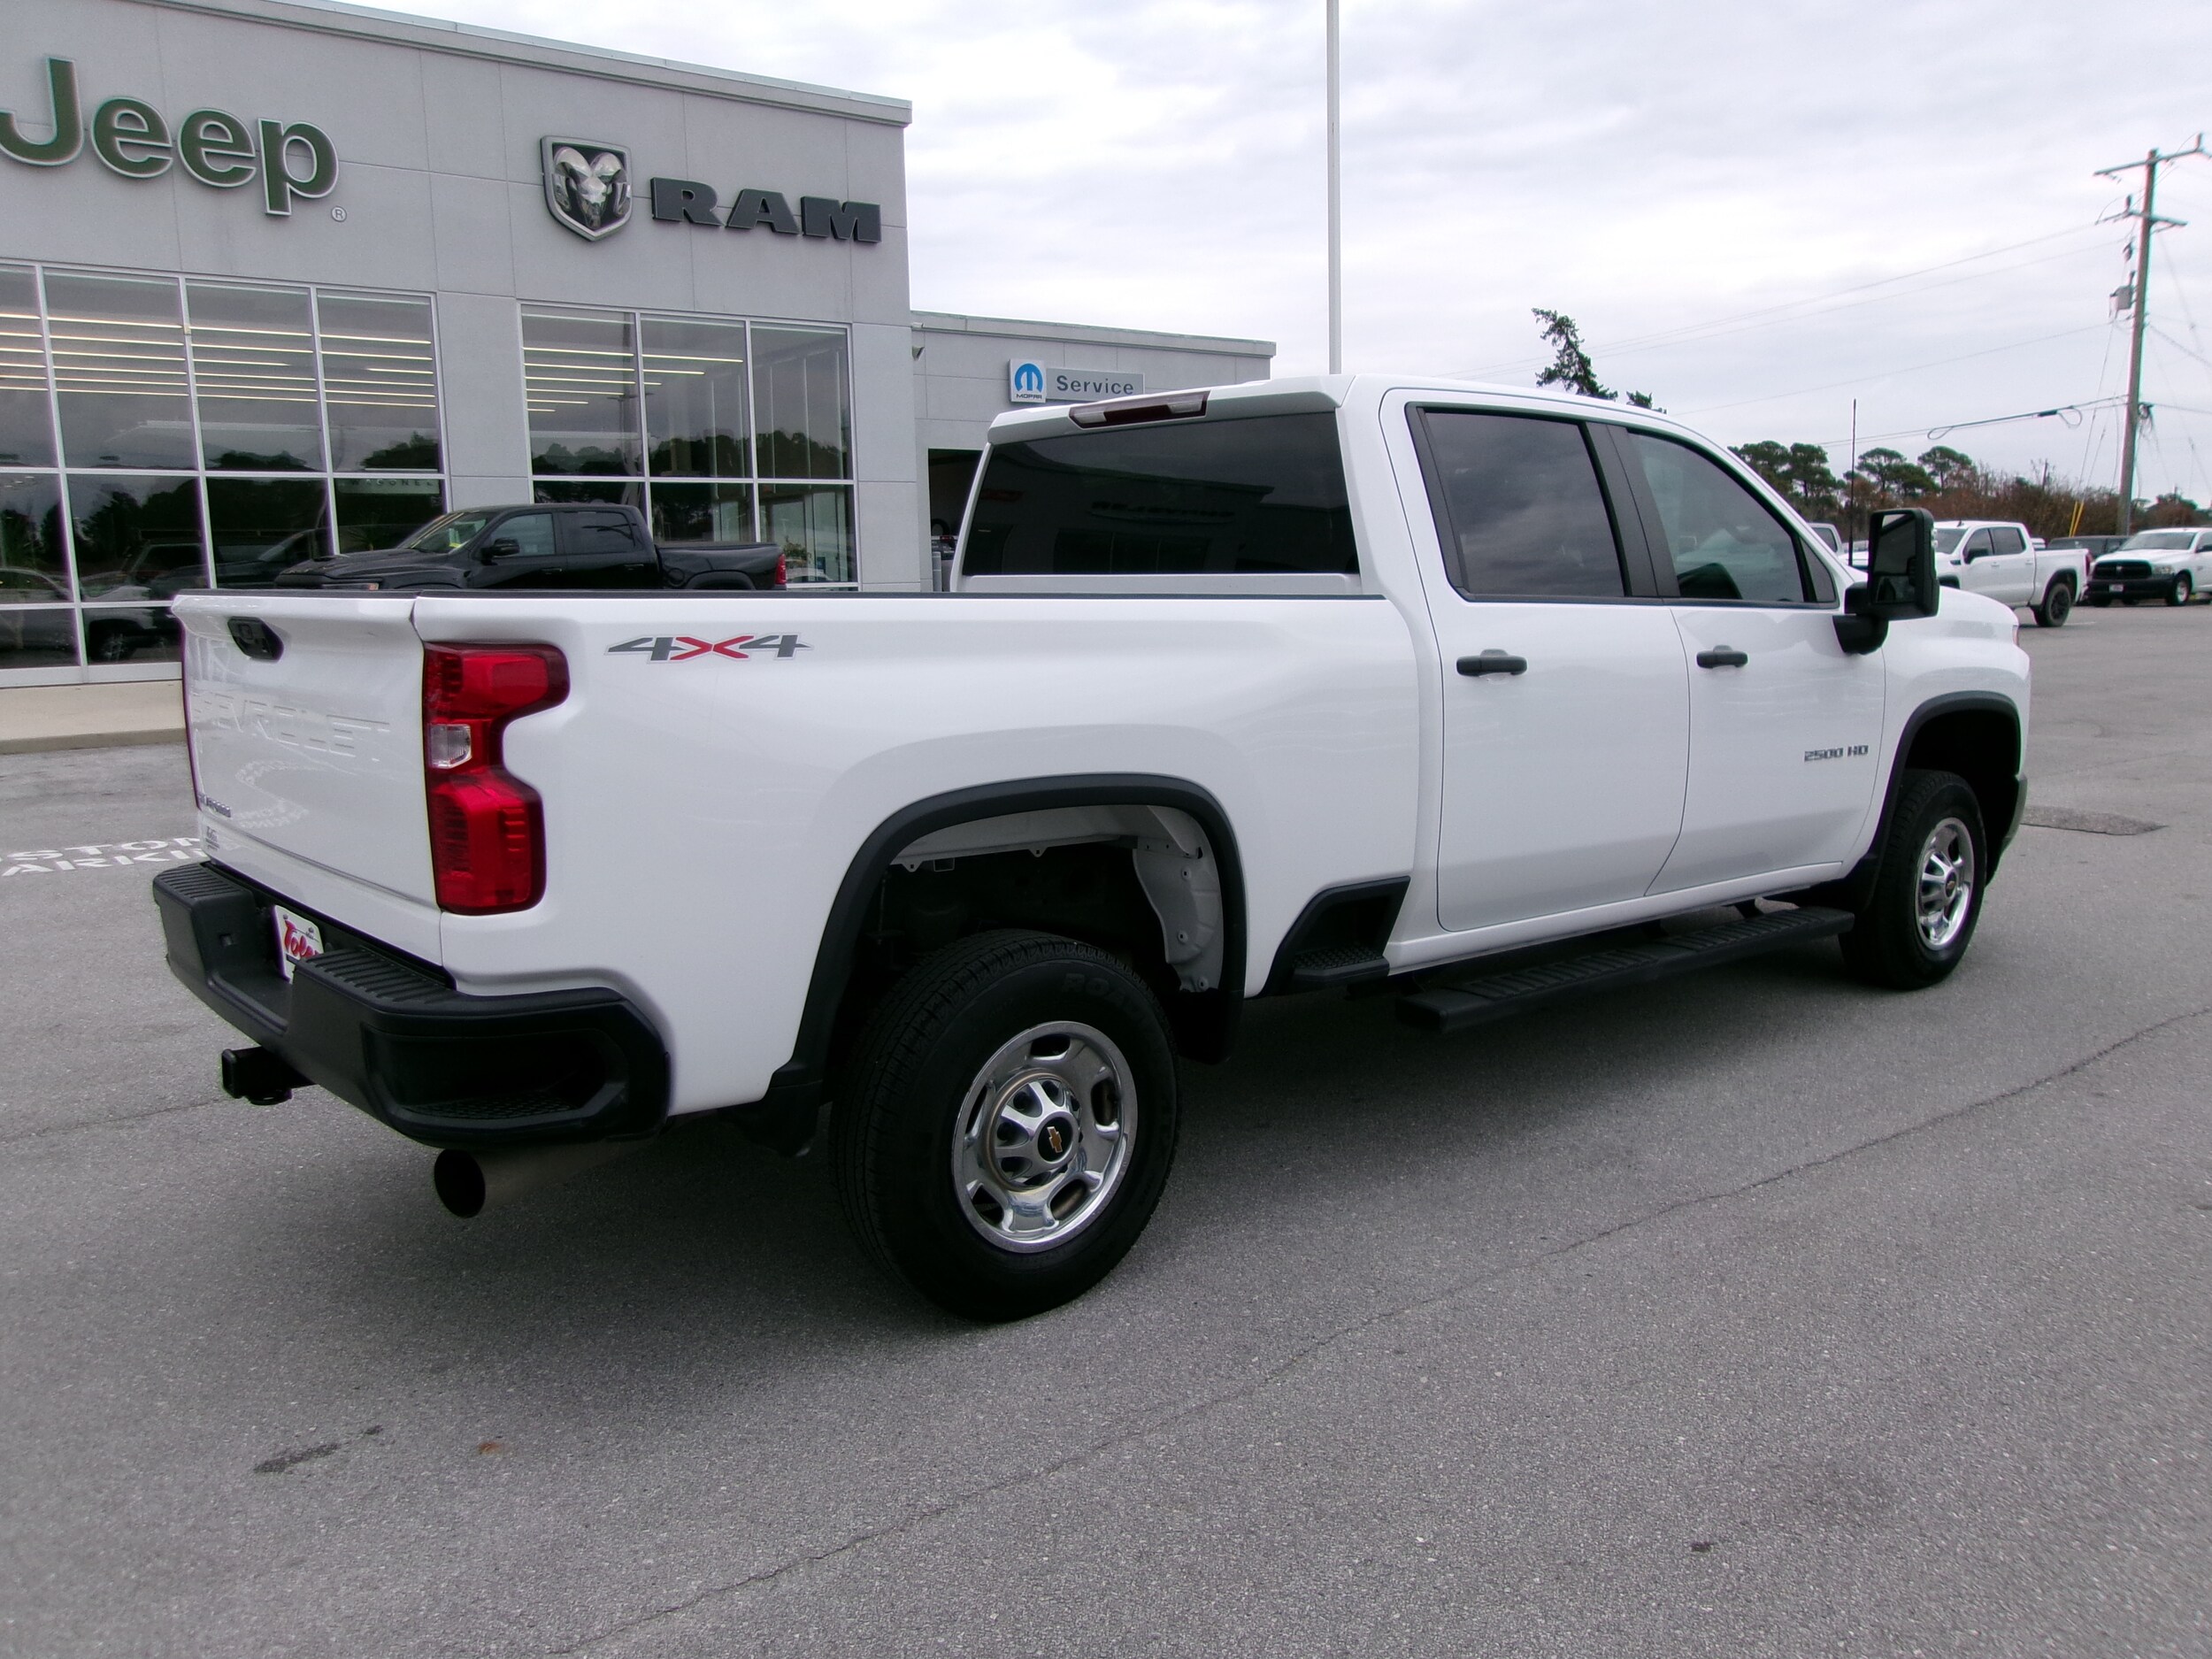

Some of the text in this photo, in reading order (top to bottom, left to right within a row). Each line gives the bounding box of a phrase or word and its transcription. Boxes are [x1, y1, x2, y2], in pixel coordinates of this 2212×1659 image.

[0, 56, 340, 216] Jeep
[650, 177, 882, 243] RAM
[1056, 374, 1134, 396] Service
[1803, 745, 1869, 762] 2500 HD
